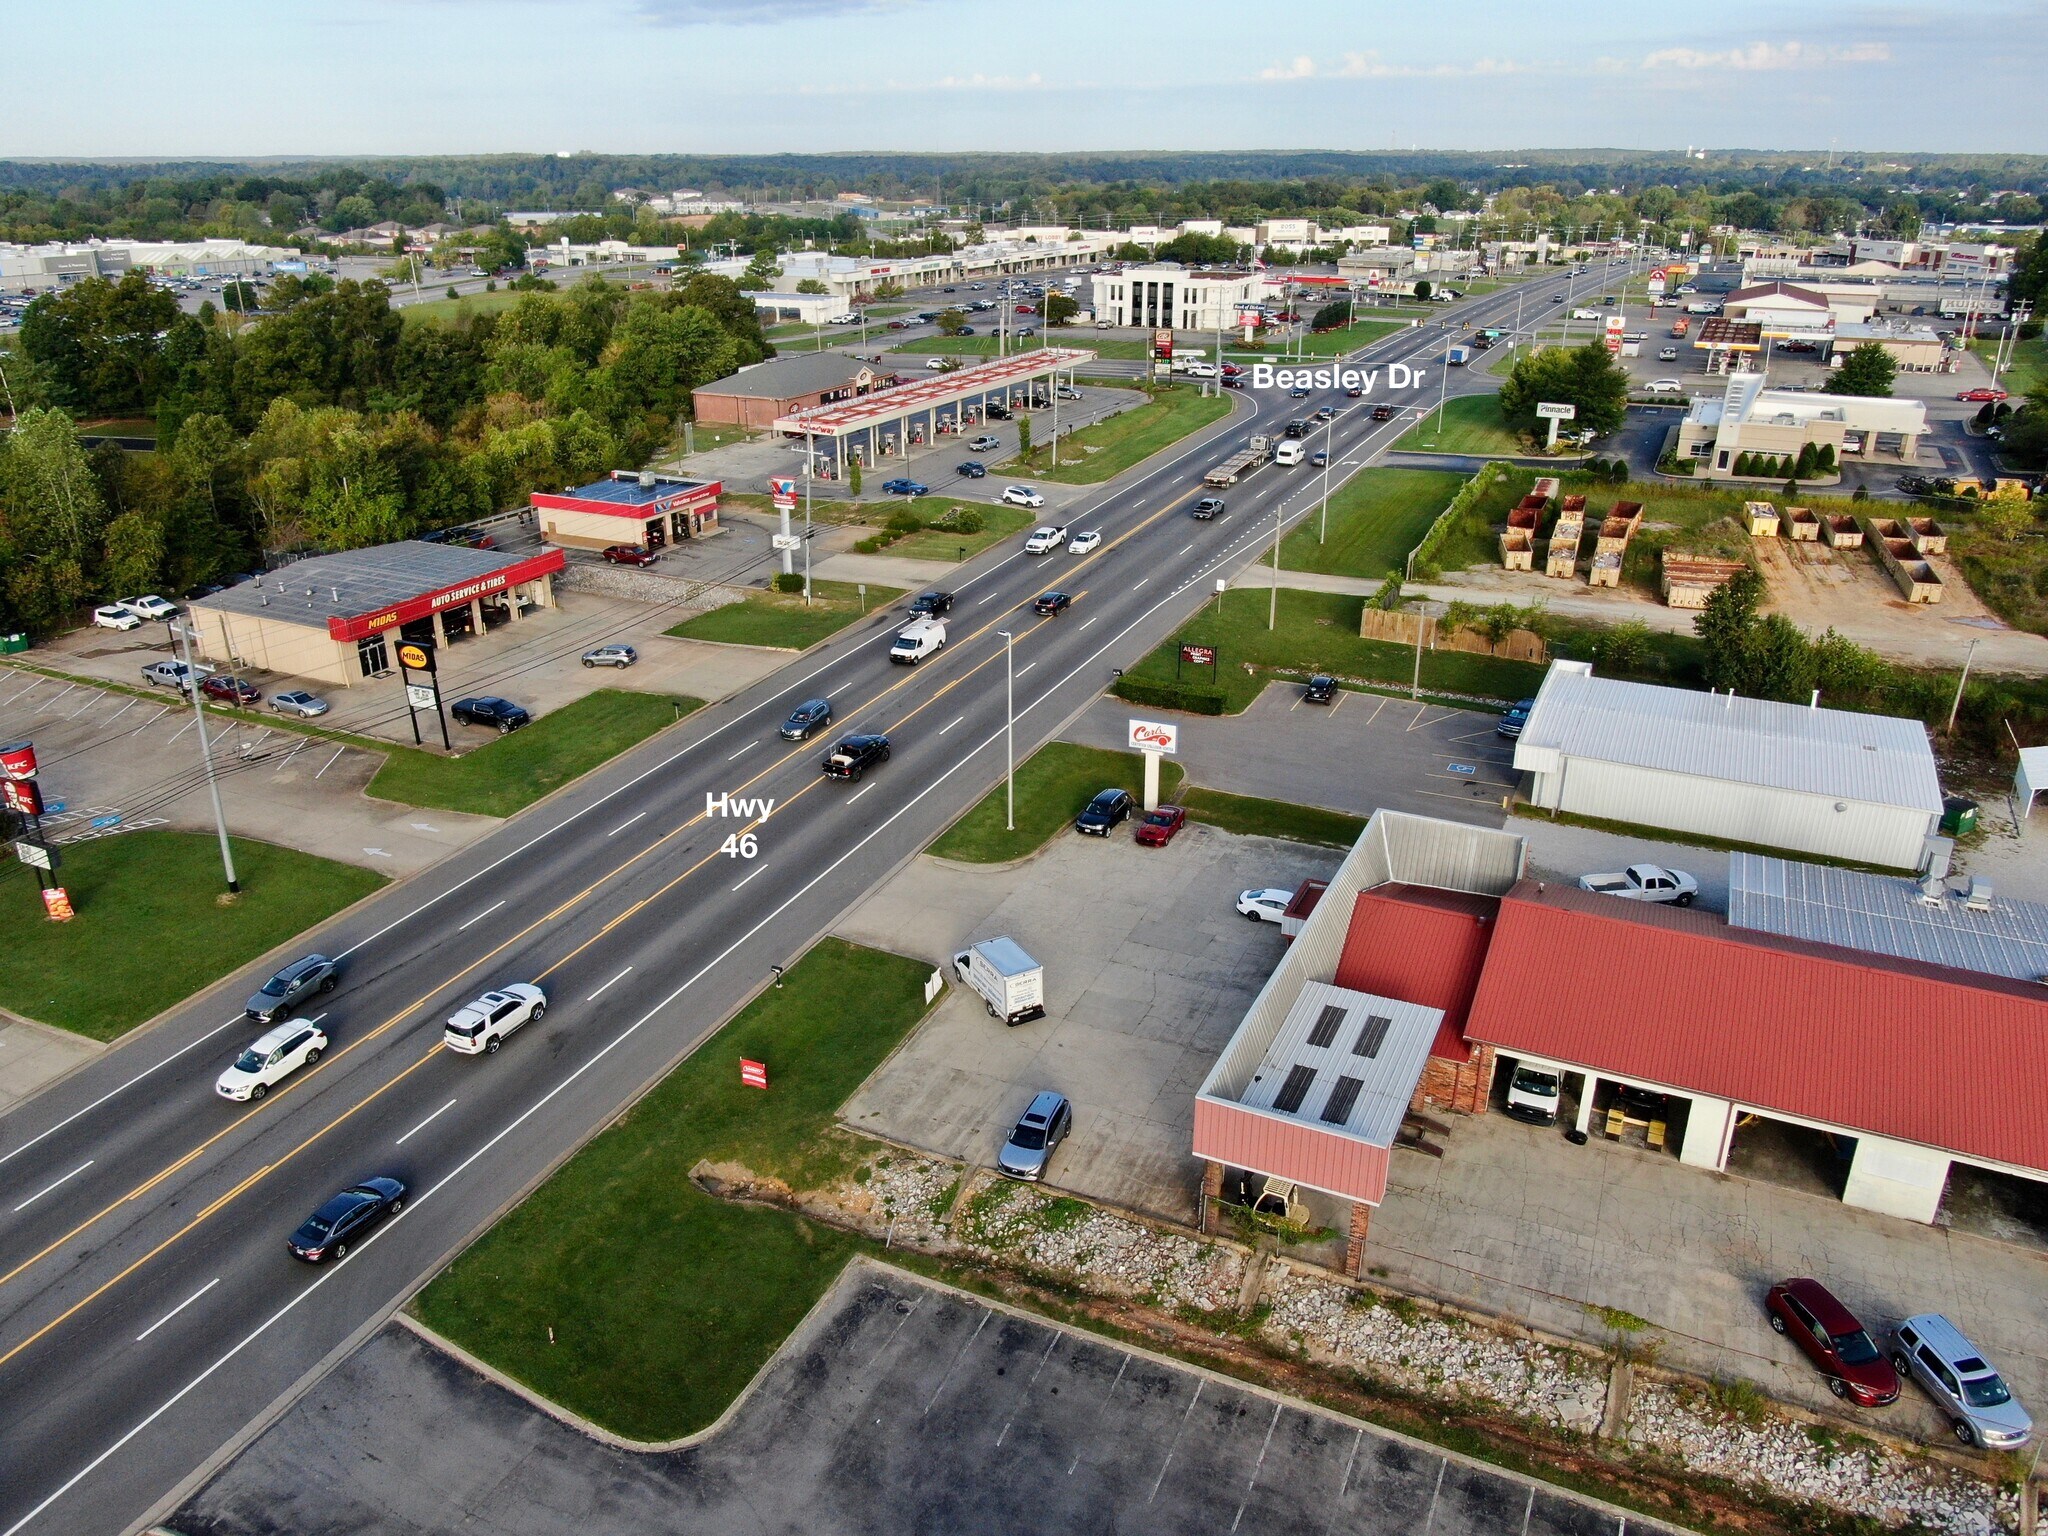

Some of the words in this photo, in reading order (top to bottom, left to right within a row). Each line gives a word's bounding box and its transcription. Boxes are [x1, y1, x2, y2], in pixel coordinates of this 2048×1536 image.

[431, 594, 451, 608] AUTO
[451, 583, 480, 601] SERVICE
[481, 581, 487, 592] &
[487, 575, 506, 589] TIRES
[368, 612, 397, 629] MIDAS
[1183, 646, 1213, 656] ALLEGRA
[402, 652, 425, 662] MIDAS
[7, 760, 28, 770] KFC
[18, 795, 33, 805] KFC
